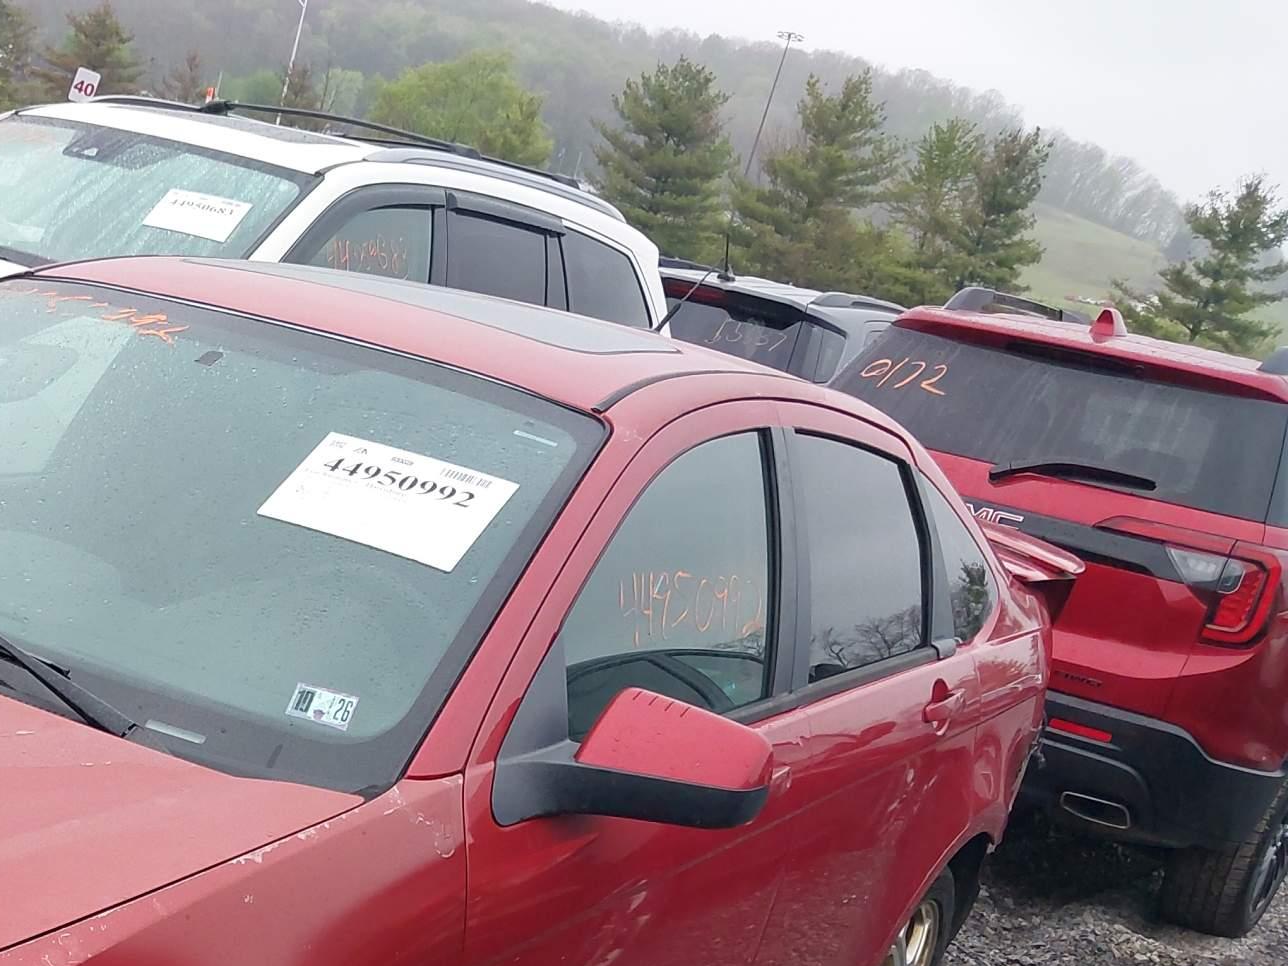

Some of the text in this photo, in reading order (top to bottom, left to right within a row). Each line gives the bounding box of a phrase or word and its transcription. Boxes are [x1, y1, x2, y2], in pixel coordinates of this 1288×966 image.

[73, 80, 95, 97] 40
[323, 456, 476, 508] 44950992
[965, 503, 1025, 530] MC
[333, 698, 354, 723] 26
